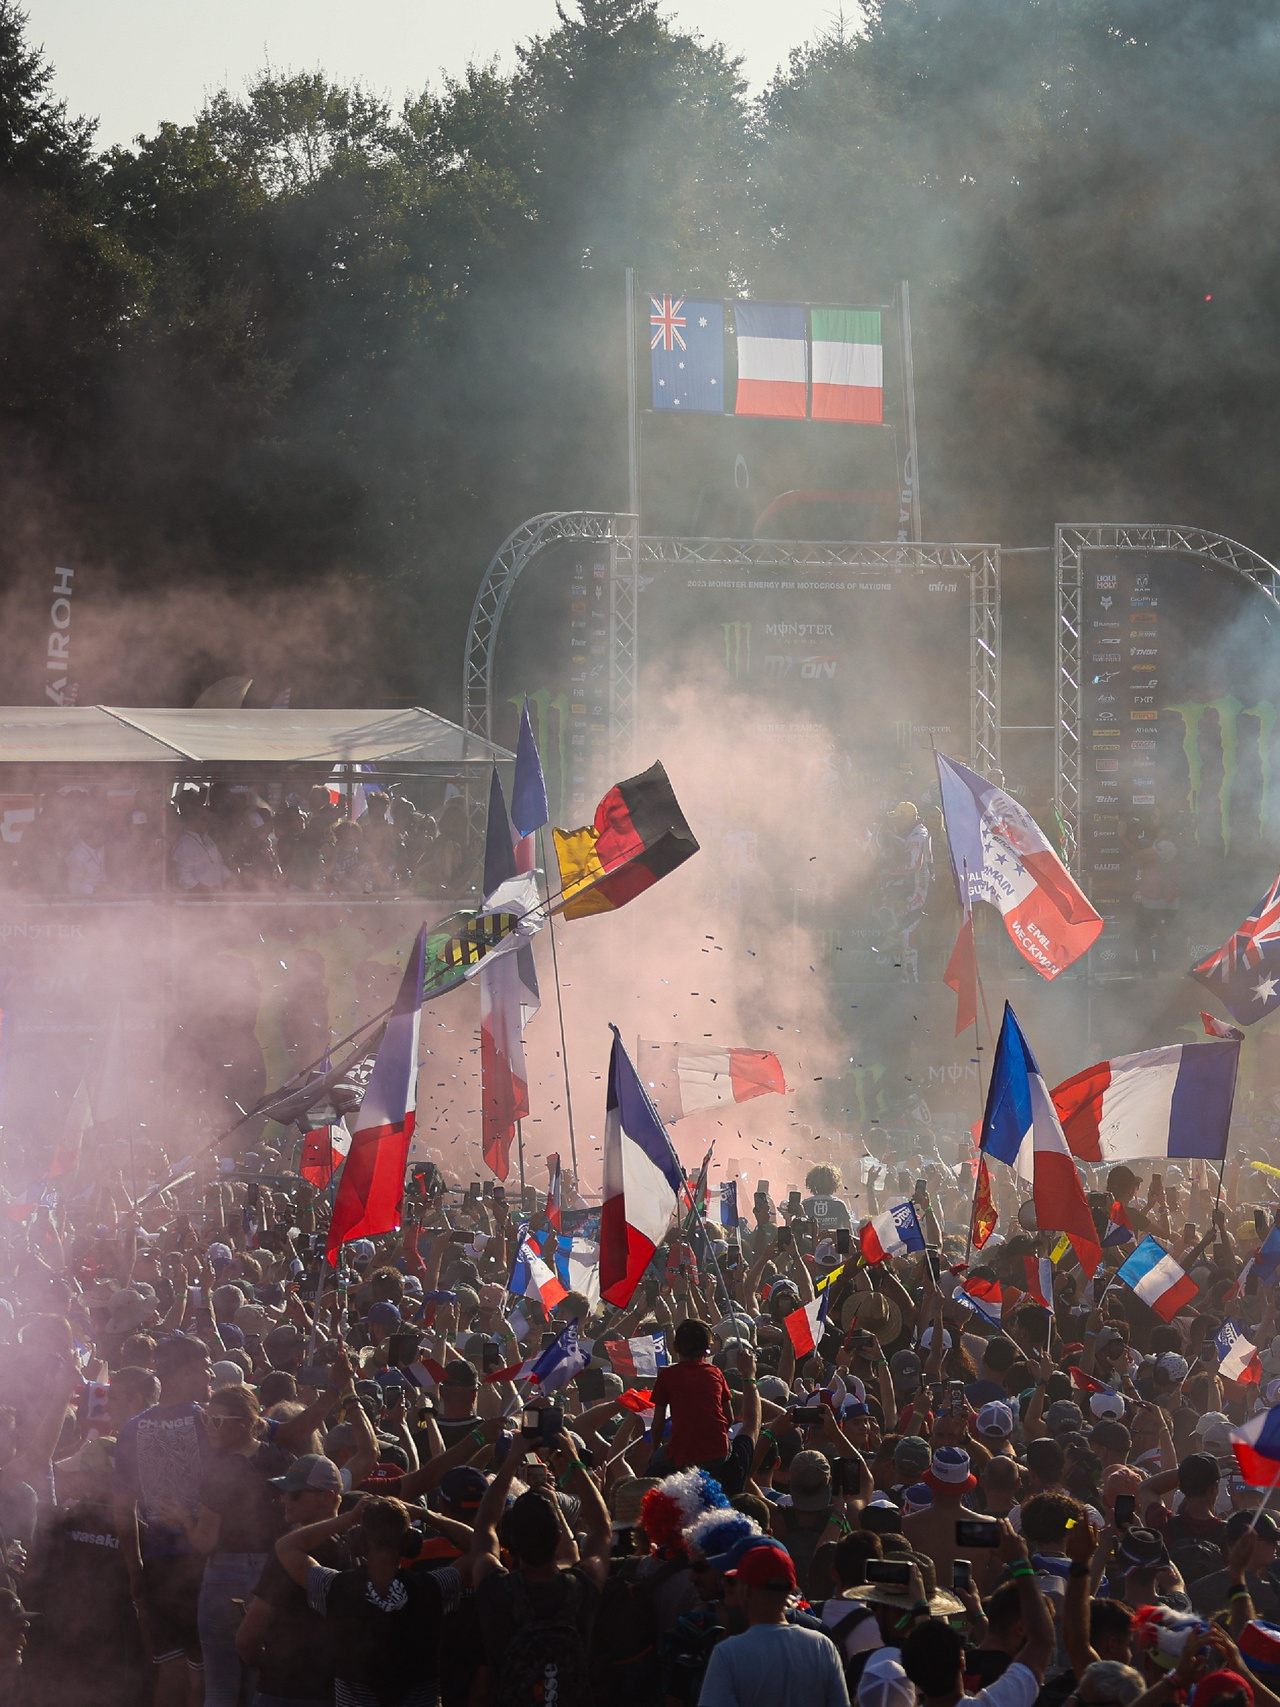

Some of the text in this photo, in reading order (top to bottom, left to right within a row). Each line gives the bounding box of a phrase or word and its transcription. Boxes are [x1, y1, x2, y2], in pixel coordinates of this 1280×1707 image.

[687, 580, 892, 591] 2023 MONSTER ENERGY FIM MOTOCROSS OF NATIONS
[44, 566, 75, 707] AIROH
[765, 620, 835, 637] MONSTER
[1136, 648, 1158, 656] THOR
[1134, 696, 1154, 704] FXR
[1026, 922, 1051, 951] EMIL
[1011, 920, 1061, 975] WECKMAN
